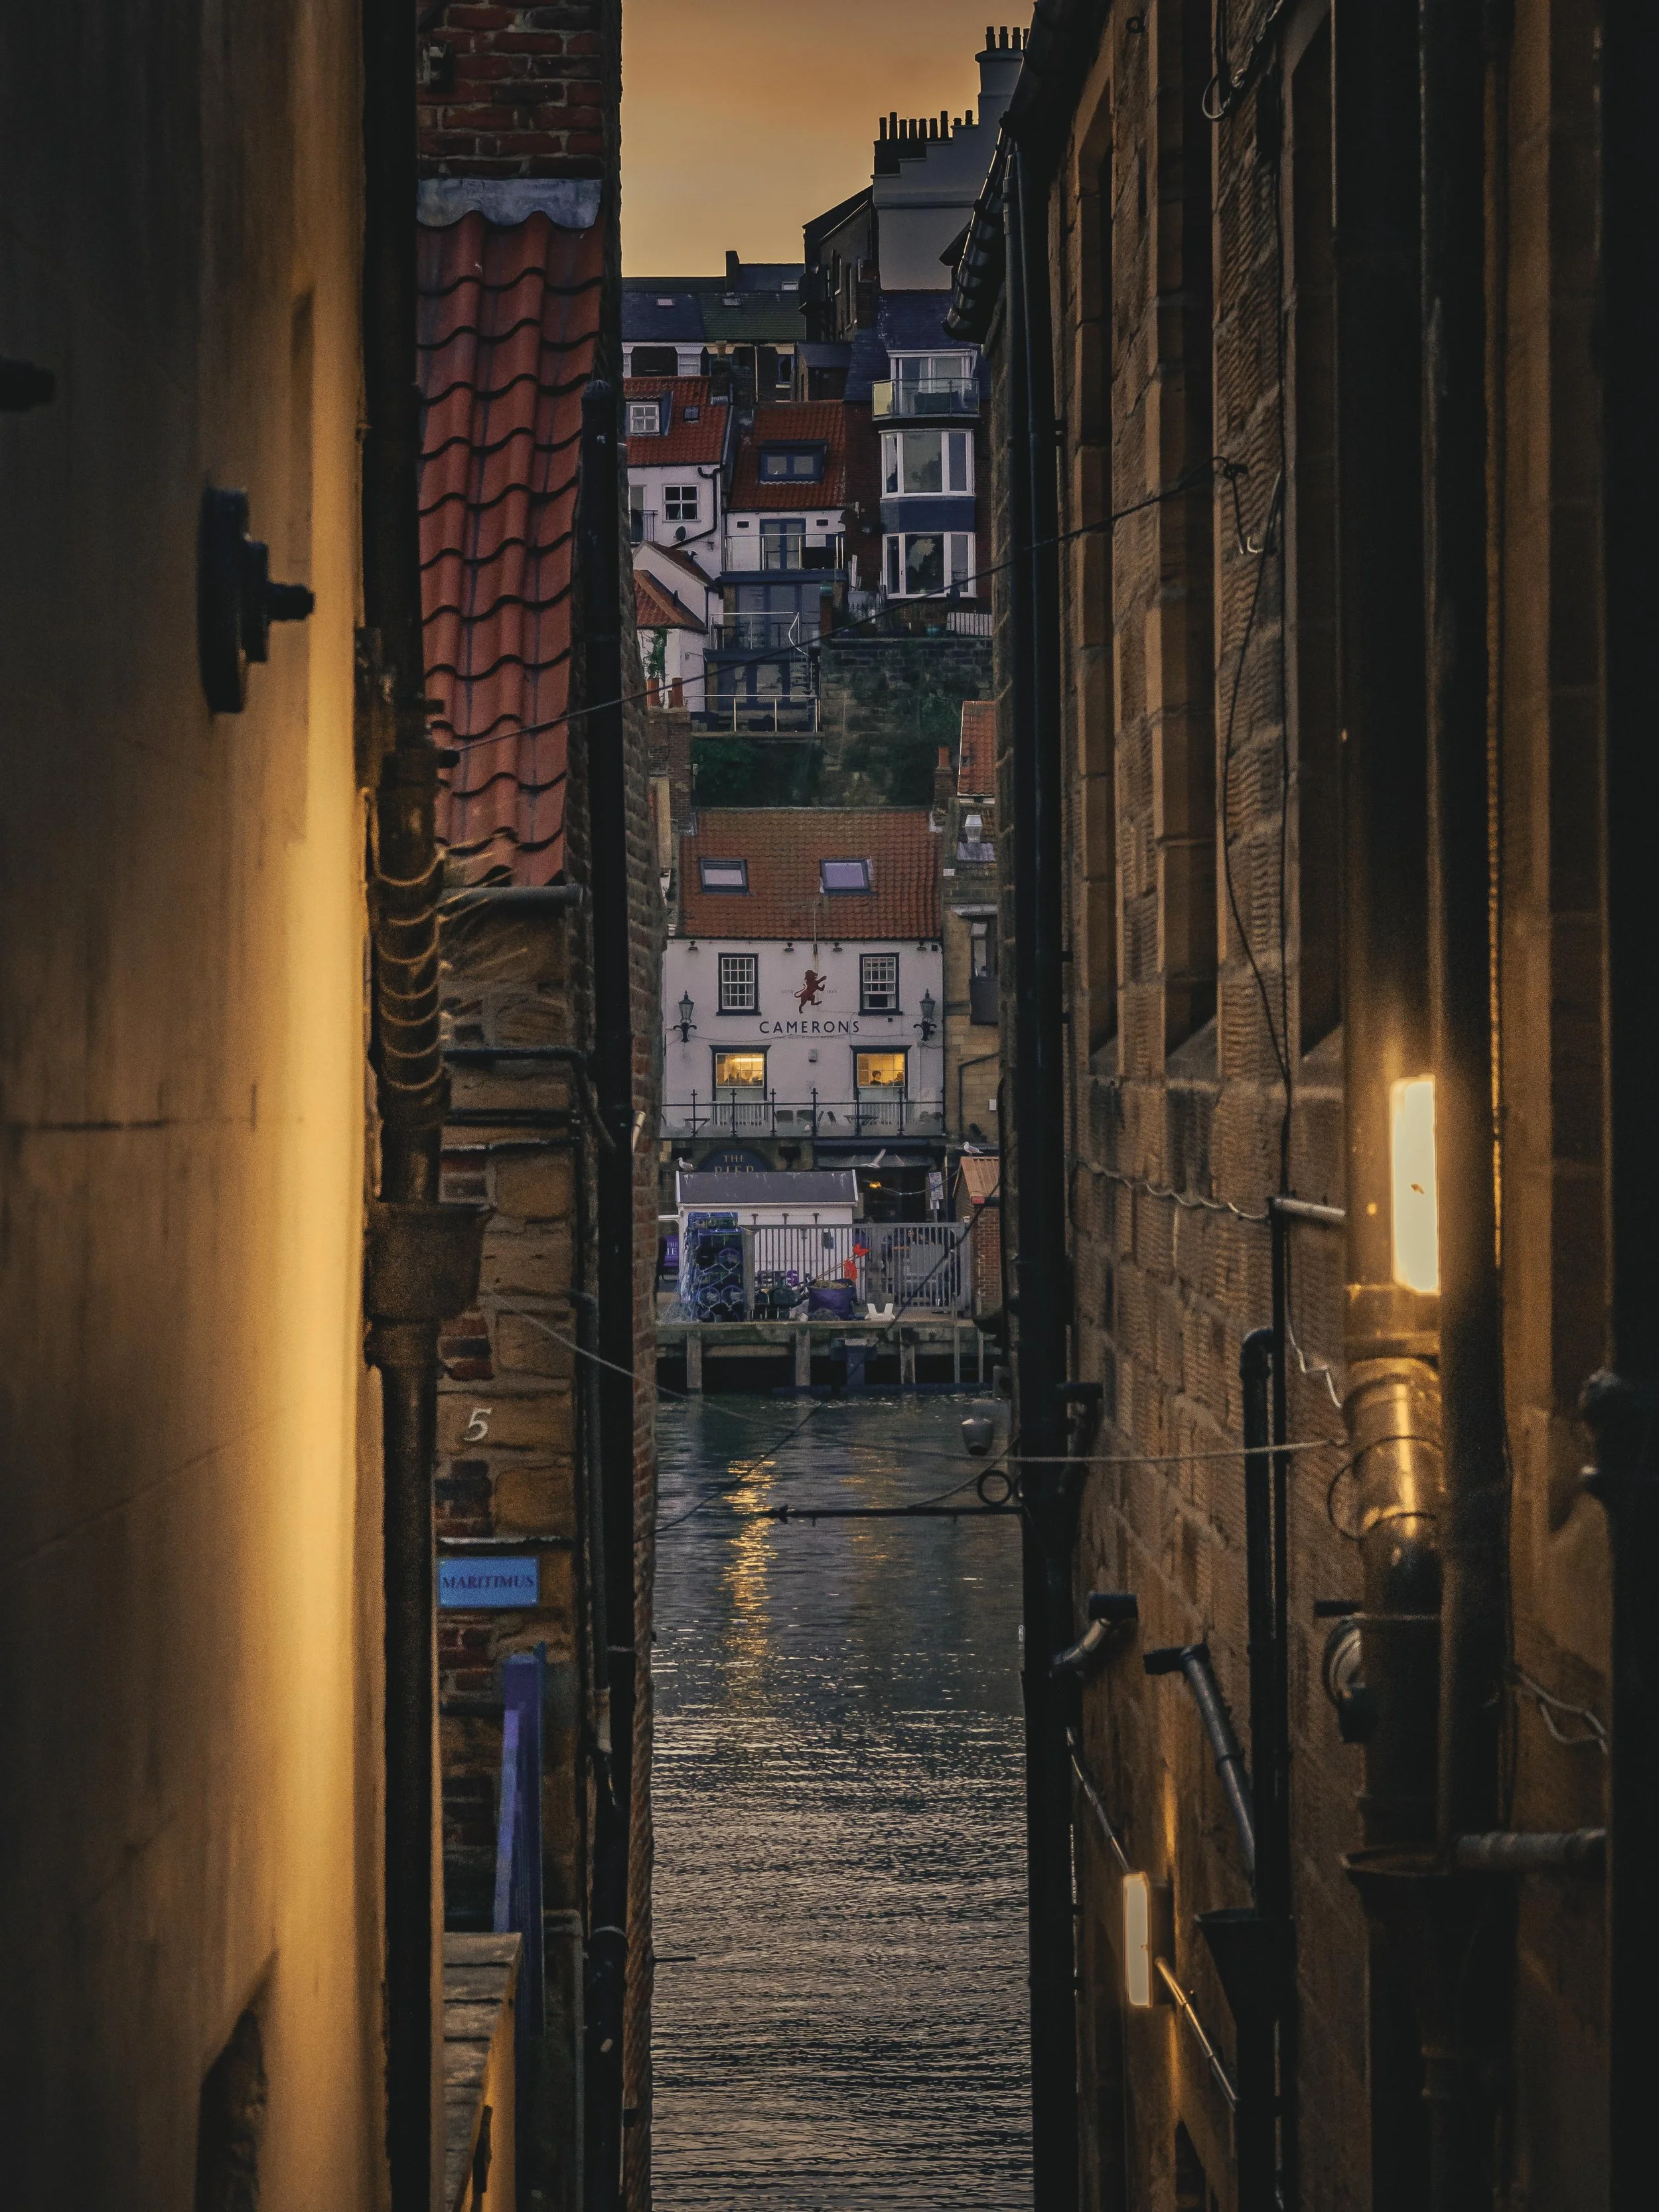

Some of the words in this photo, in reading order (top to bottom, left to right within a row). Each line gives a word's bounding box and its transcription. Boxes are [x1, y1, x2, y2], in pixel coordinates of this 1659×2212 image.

[759, 1021, 859, 1034] CAMERONS
[464, 1407, 492, 1441] 5
[443, 1575, 535, 1589] MARITIMUS
